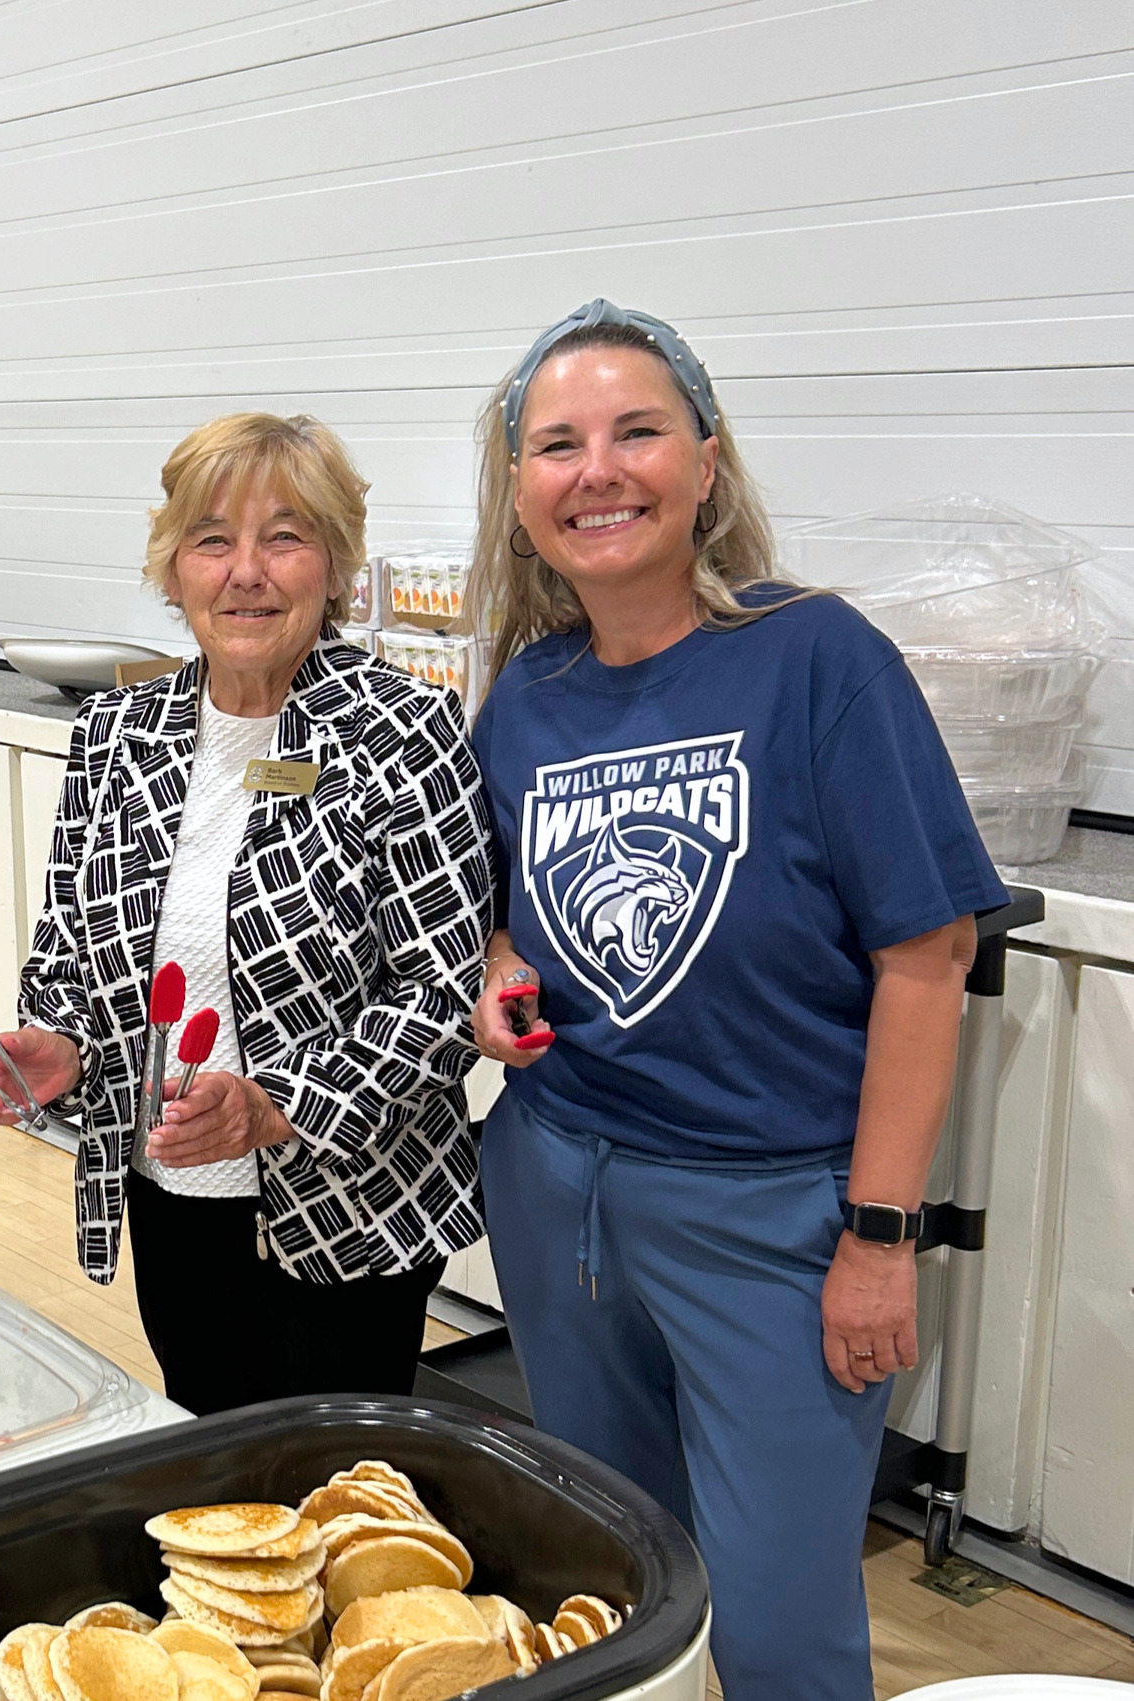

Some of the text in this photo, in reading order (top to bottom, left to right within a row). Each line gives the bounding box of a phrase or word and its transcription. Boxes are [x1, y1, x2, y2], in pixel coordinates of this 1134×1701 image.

[548, 748, 725, 798] WILLOW PARK
[534, 774, 733, 865] WILDCATS
